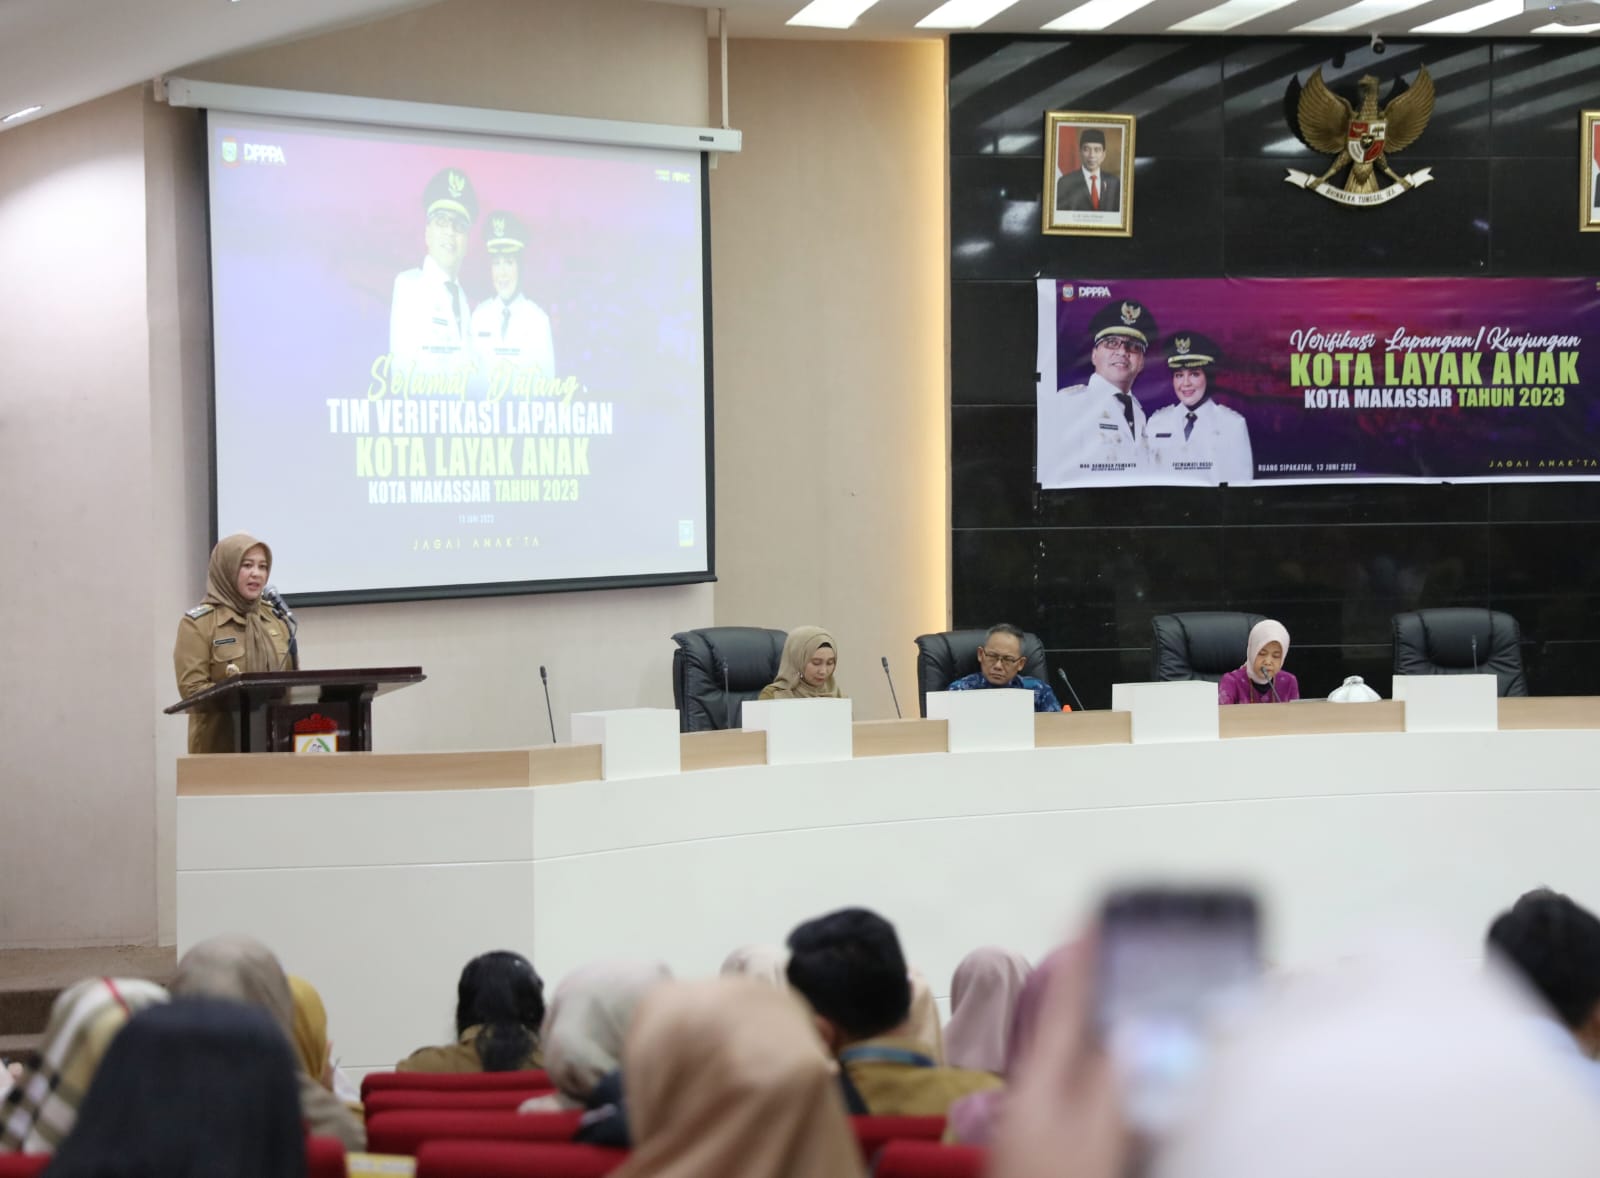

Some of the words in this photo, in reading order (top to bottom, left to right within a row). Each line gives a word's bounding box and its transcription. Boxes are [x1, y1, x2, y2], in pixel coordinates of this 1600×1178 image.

[1078, 286, 1111, 298] DPPPA
[1290, 326, 1376, 353] Verifikasi
[1486, 326, 1582, 354] Kunjungan
[367, 352, 478, 403] Selamat
[1290, 352, 1375, 387] KOTA
[1384, 352, 1483, 386] LAYAK
[1491, 351, 1580, 385] ANAK
[1304, 388, 1350, 409] KOTA
[1353, 388, 1453, 409] MAKASSAR
[1456, 387, 1515, 408] TAHUN
[1518, 386, 1566, 407] 2023
[327, 398, 370, 434] TIM
[376, 399, 499, 435] VERIFIKASI
[506, 401, 614, 436] LAPANGAN
[355, 437, 428, 478] KOTA
[435, 437, 515, 477] LAYAK
[521, 437, 591, 476] ANAK
[1258, 463, 1279, 472] RUANG
[1325, 463, 1339, 471] JUNI
[368, 481, 407, 504] KOTA
[410, 480, 490, 503] MAKASSAR
[494, 480, 540, 502] TAHUN
[543, 479, 579, 501] 2023
